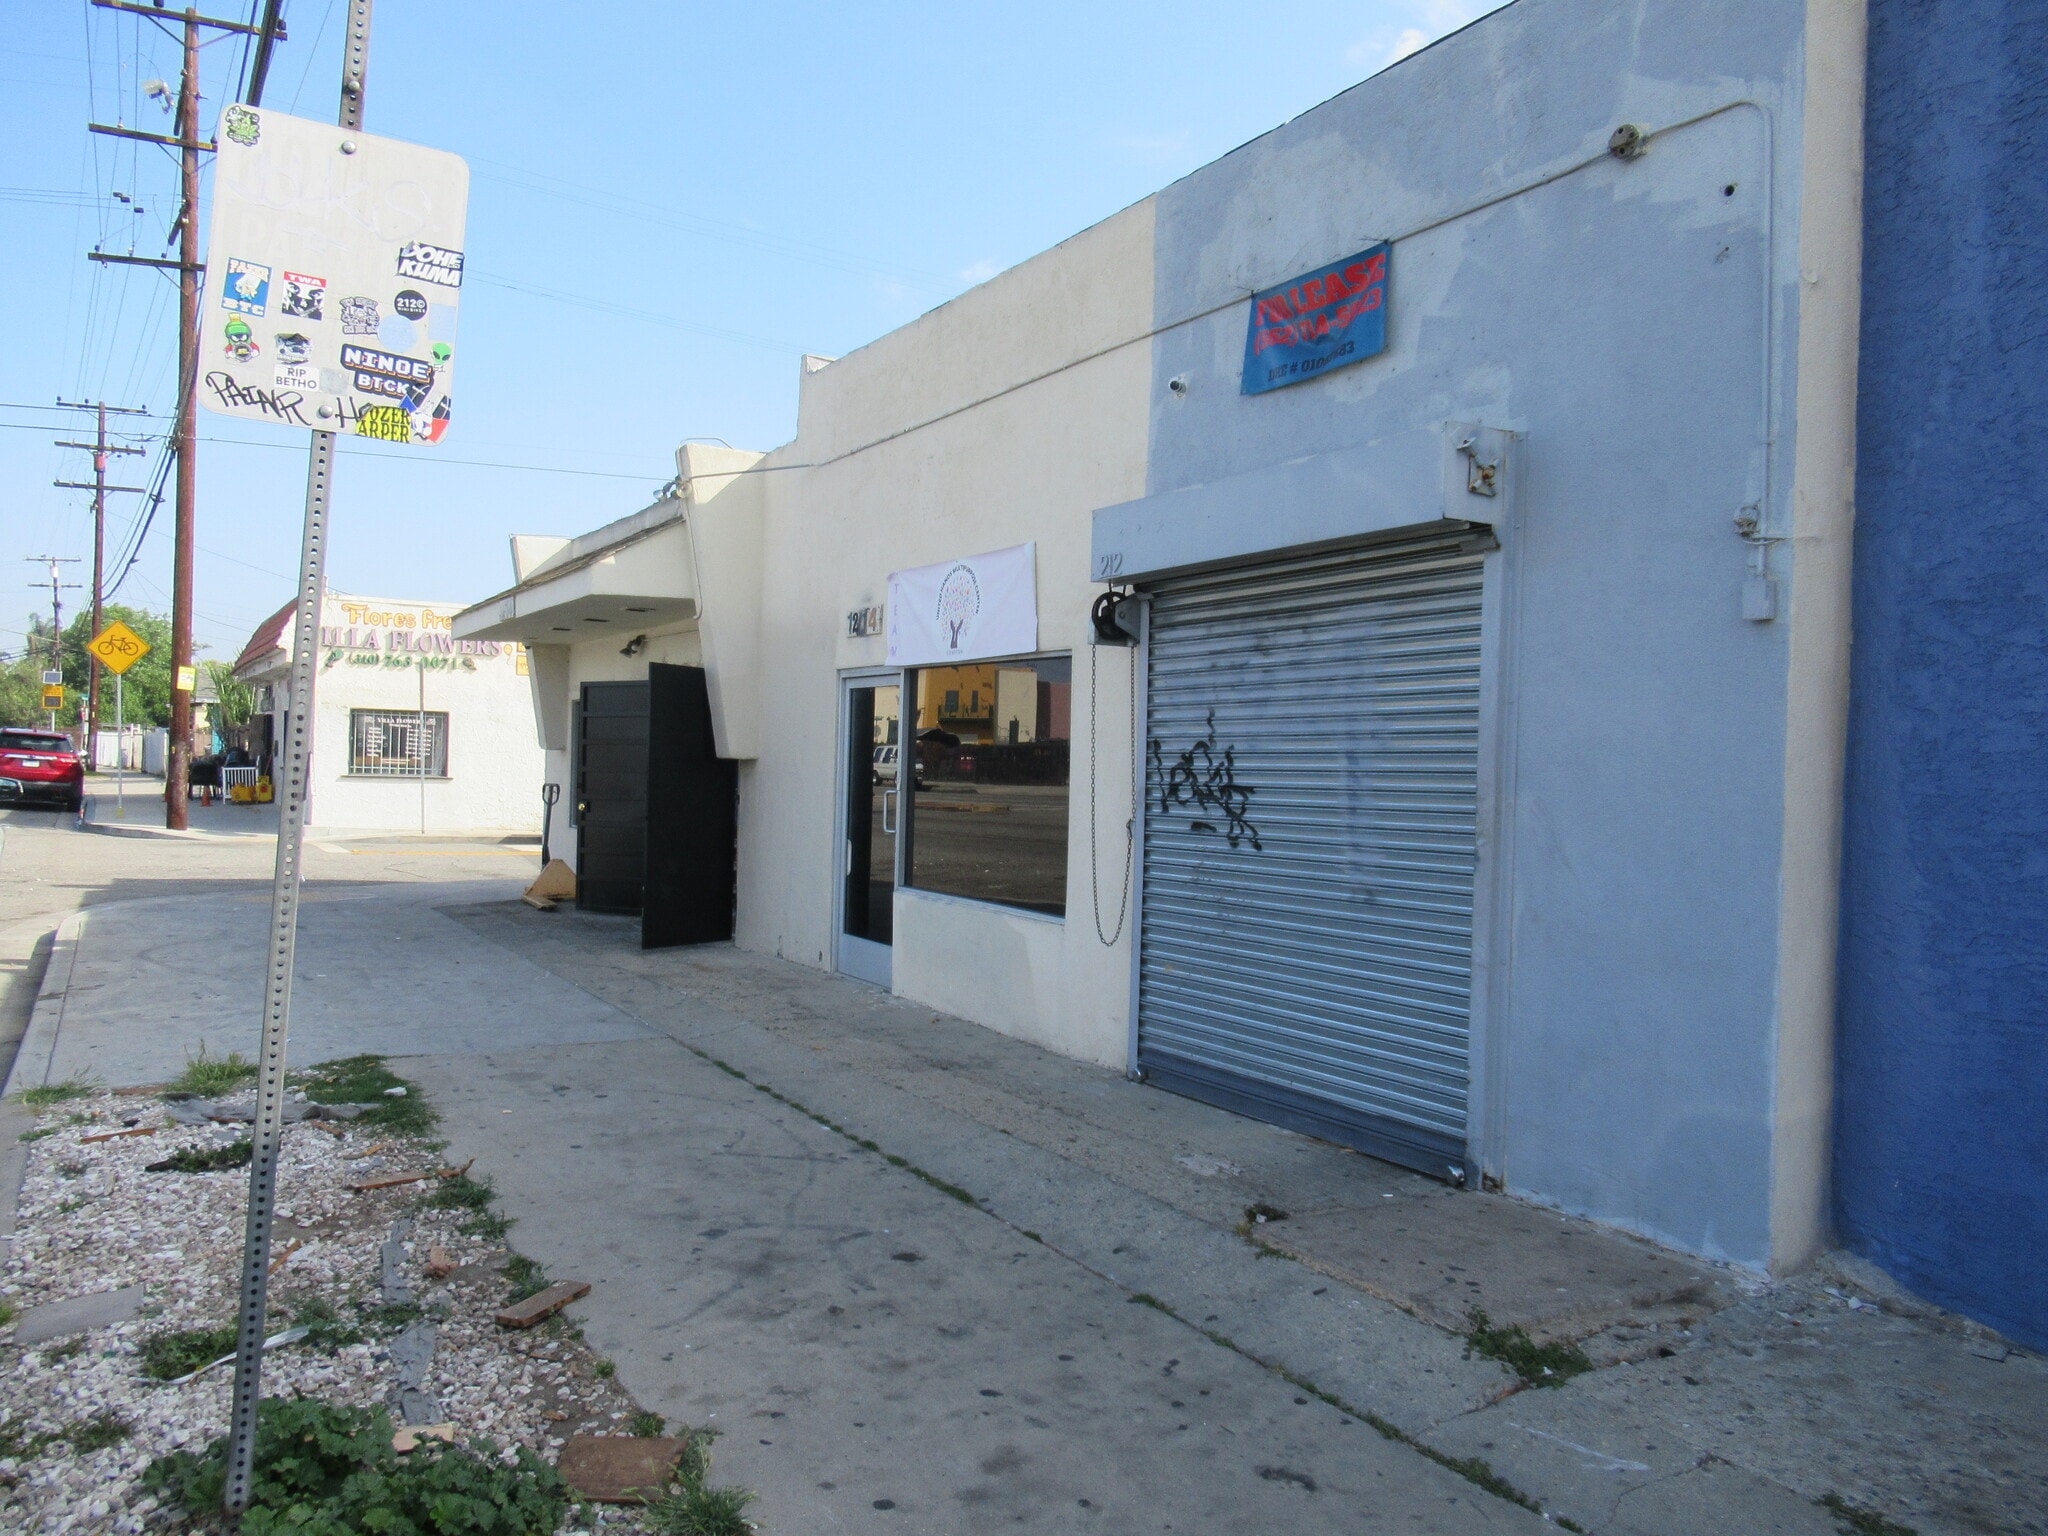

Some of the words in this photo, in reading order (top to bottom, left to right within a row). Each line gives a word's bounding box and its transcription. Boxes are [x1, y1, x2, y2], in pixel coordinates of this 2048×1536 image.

[288, 274, 322, 287] TWA
[1288, 252, 1387, 315] LEASE
[287, 367, 307, 377] RIP
[276, 376, 318, 389] BETHO
[341, 603, 416, 629] Flores
[390, 630, 503, 657] FLOWERS
